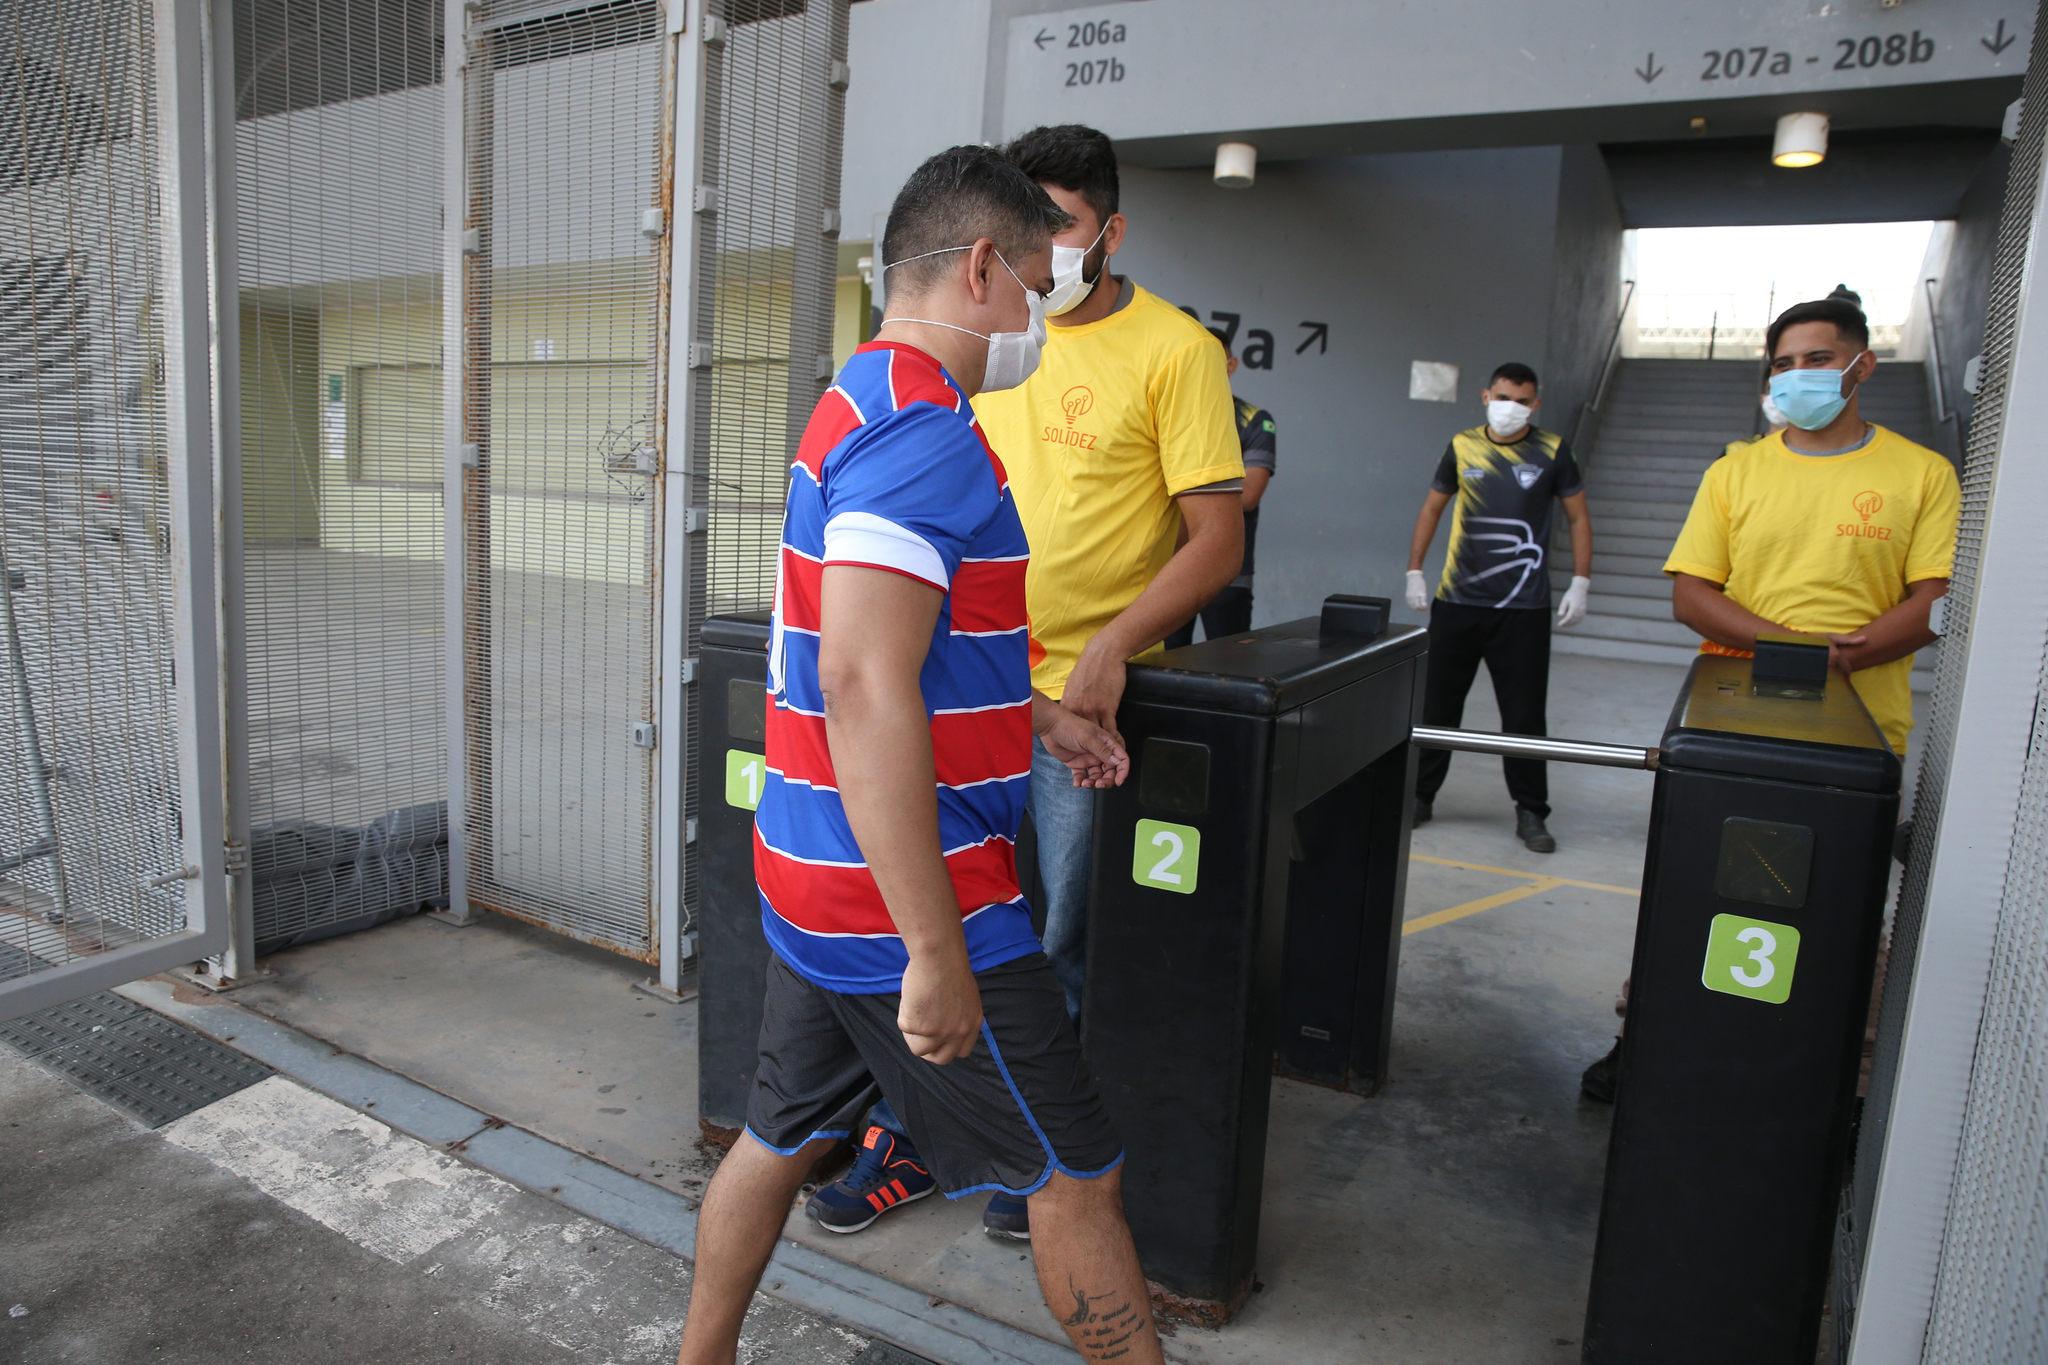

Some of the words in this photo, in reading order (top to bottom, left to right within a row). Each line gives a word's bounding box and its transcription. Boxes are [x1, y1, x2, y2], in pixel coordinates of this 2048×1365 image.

[1066, 20, 1127, 49] 206a
[1700, 46, 1792, 81] 207a
[1833, 29, 1935, 71] 208b
[1064, 56, 1126, 88] 207b
[1178, 306, 1275, 371] 7a
[1041, 426, 1098, 452] SOLIDEZ
[1835, 523, 1893, 541] SOLIDEZ
[740, 759, 759, 805] 1
[1148, 831, 1184, 885] 2
[1729, 927, 1777, 988] 3
